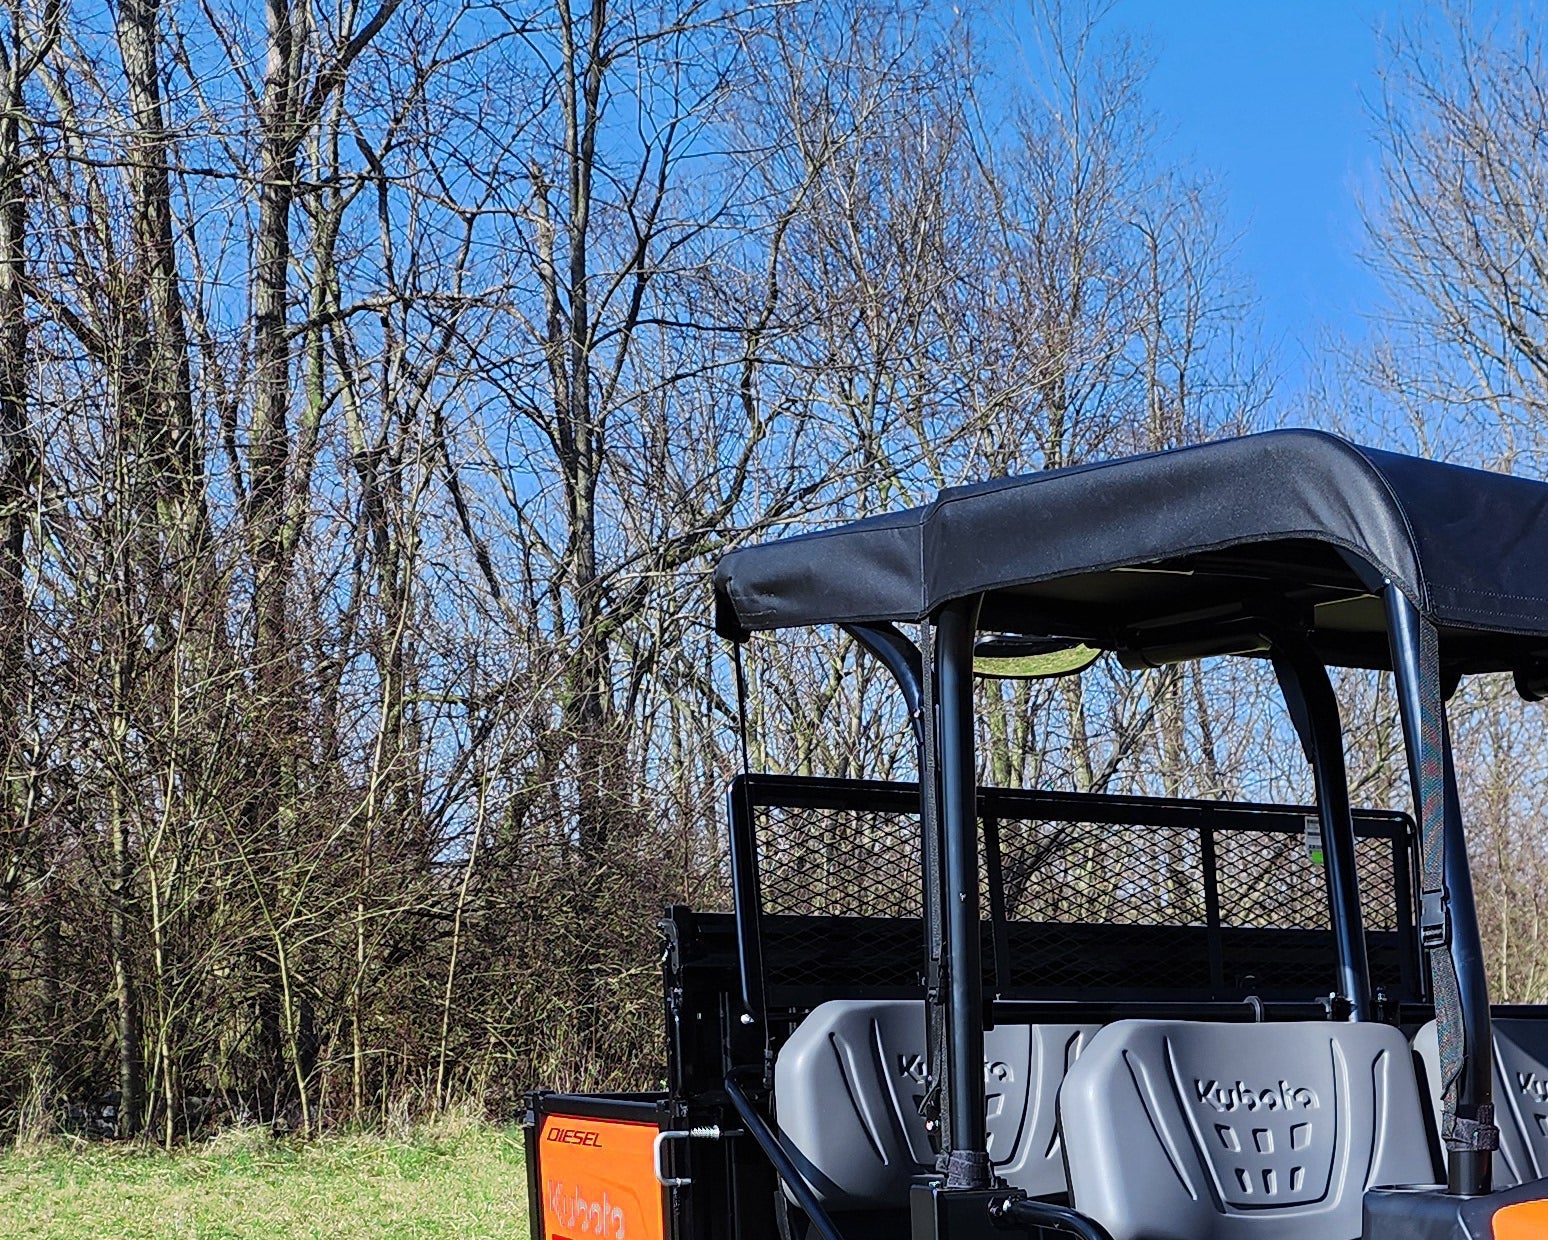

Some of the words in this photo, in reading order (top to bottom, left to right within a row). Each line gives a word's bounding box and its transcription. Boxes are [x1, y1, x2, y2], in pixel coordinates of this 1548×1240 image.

[1194, 1079, 1320, 1112] Kubota
[547, 1127, 603, 1148] DIESEL
[548, 1179, 625, 1240] Kubota
